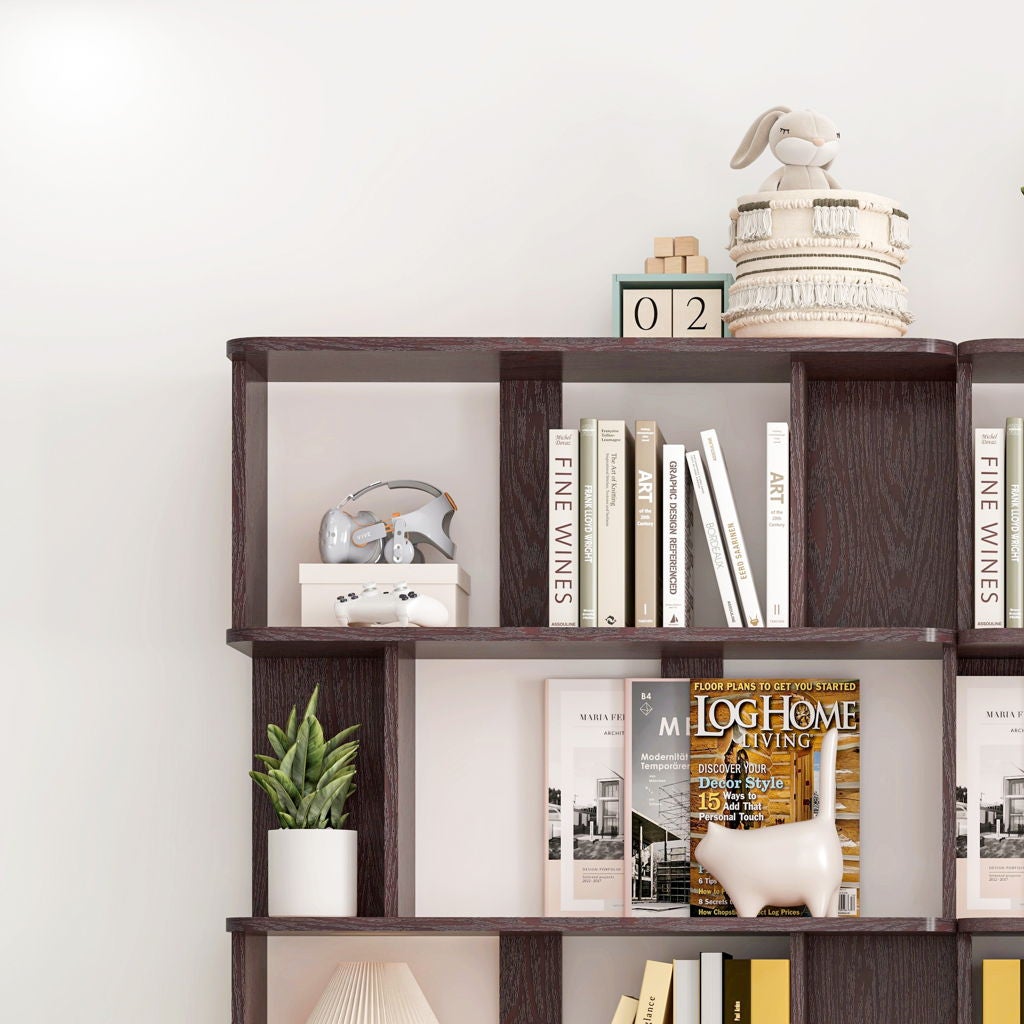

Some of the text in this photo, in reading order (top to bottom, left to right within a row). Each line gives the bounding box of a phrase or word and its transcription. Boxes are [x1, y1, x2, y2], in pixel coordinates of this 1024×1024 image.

[686, 296, 707, 330] 2
[555, 457, 572, 511] FINE
[638, 470, 653, 503] ART
[770, 472, 784, 504] ART
[981, 456, 998, 510] FINE
[584, 485, 593, 564] FRANK LLOYD WRIGHT
[669, 460, 677, 595] GRAPHIC DESIGN REFERENCED
[706, 522, 723, 569] BORDEAUX
[728, 522, 747, 580] EERO SAARINEN
[555, 523, 572, 604] WINES
[981, 522, 998, 603] WINES
[694, 682, 856, 691] FLOOR PLANS TO GET YOU STARTED
[743, 733, 811, 748] LIVING
[698, 764, 766, 774] DISCOVER YOUR
[698, 777, 783, 793] Decor Style
[698, 793, 720, 810] 15
[723, 792, 756, 801] Ways to
[723, 802, 761, 810] Add That
[698, 812, 764, 821] Personal Touch
